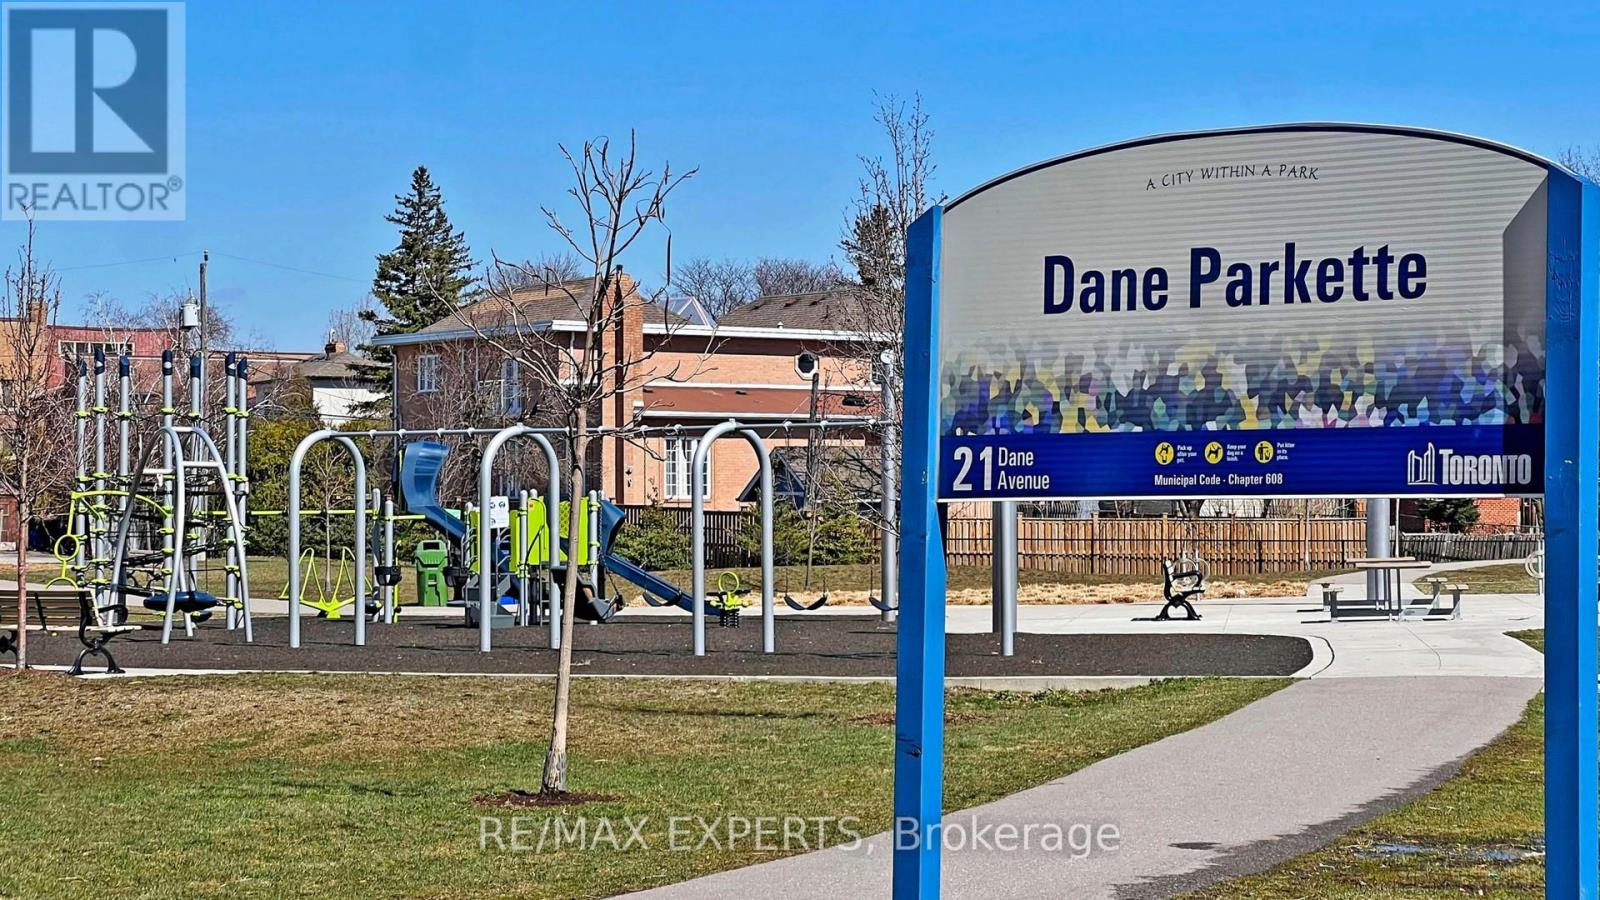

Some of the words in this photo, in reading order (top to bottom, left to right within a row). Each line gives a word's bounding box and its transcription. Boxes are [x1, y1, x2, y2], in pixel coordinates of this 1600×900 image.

[1146, 178, 1156, 191] A
[1161, 170, 1194, 187] CITY
[1200, 164, 1255, 180] WITHIN
[1261, 164, 1272, 177] A
[1279, 164, 1319, 180] PARK
[1043, 255, 1169, 315] Dane
[1189, 242, 1427, 309] Parkette
[952, 446, 993, 491] 21
[998, 446, 1034, 466] Dane
[1439, 448, 1532, 485] TORONTO
[997, 470, 1050, 490] Avenue
[1154, 474, 1197, 487] Municipal
[1199, 474, 1221, 485] Code
[1228, 473, 1262, 487] Chapter
[1265, 473, 1283, 485] 608
